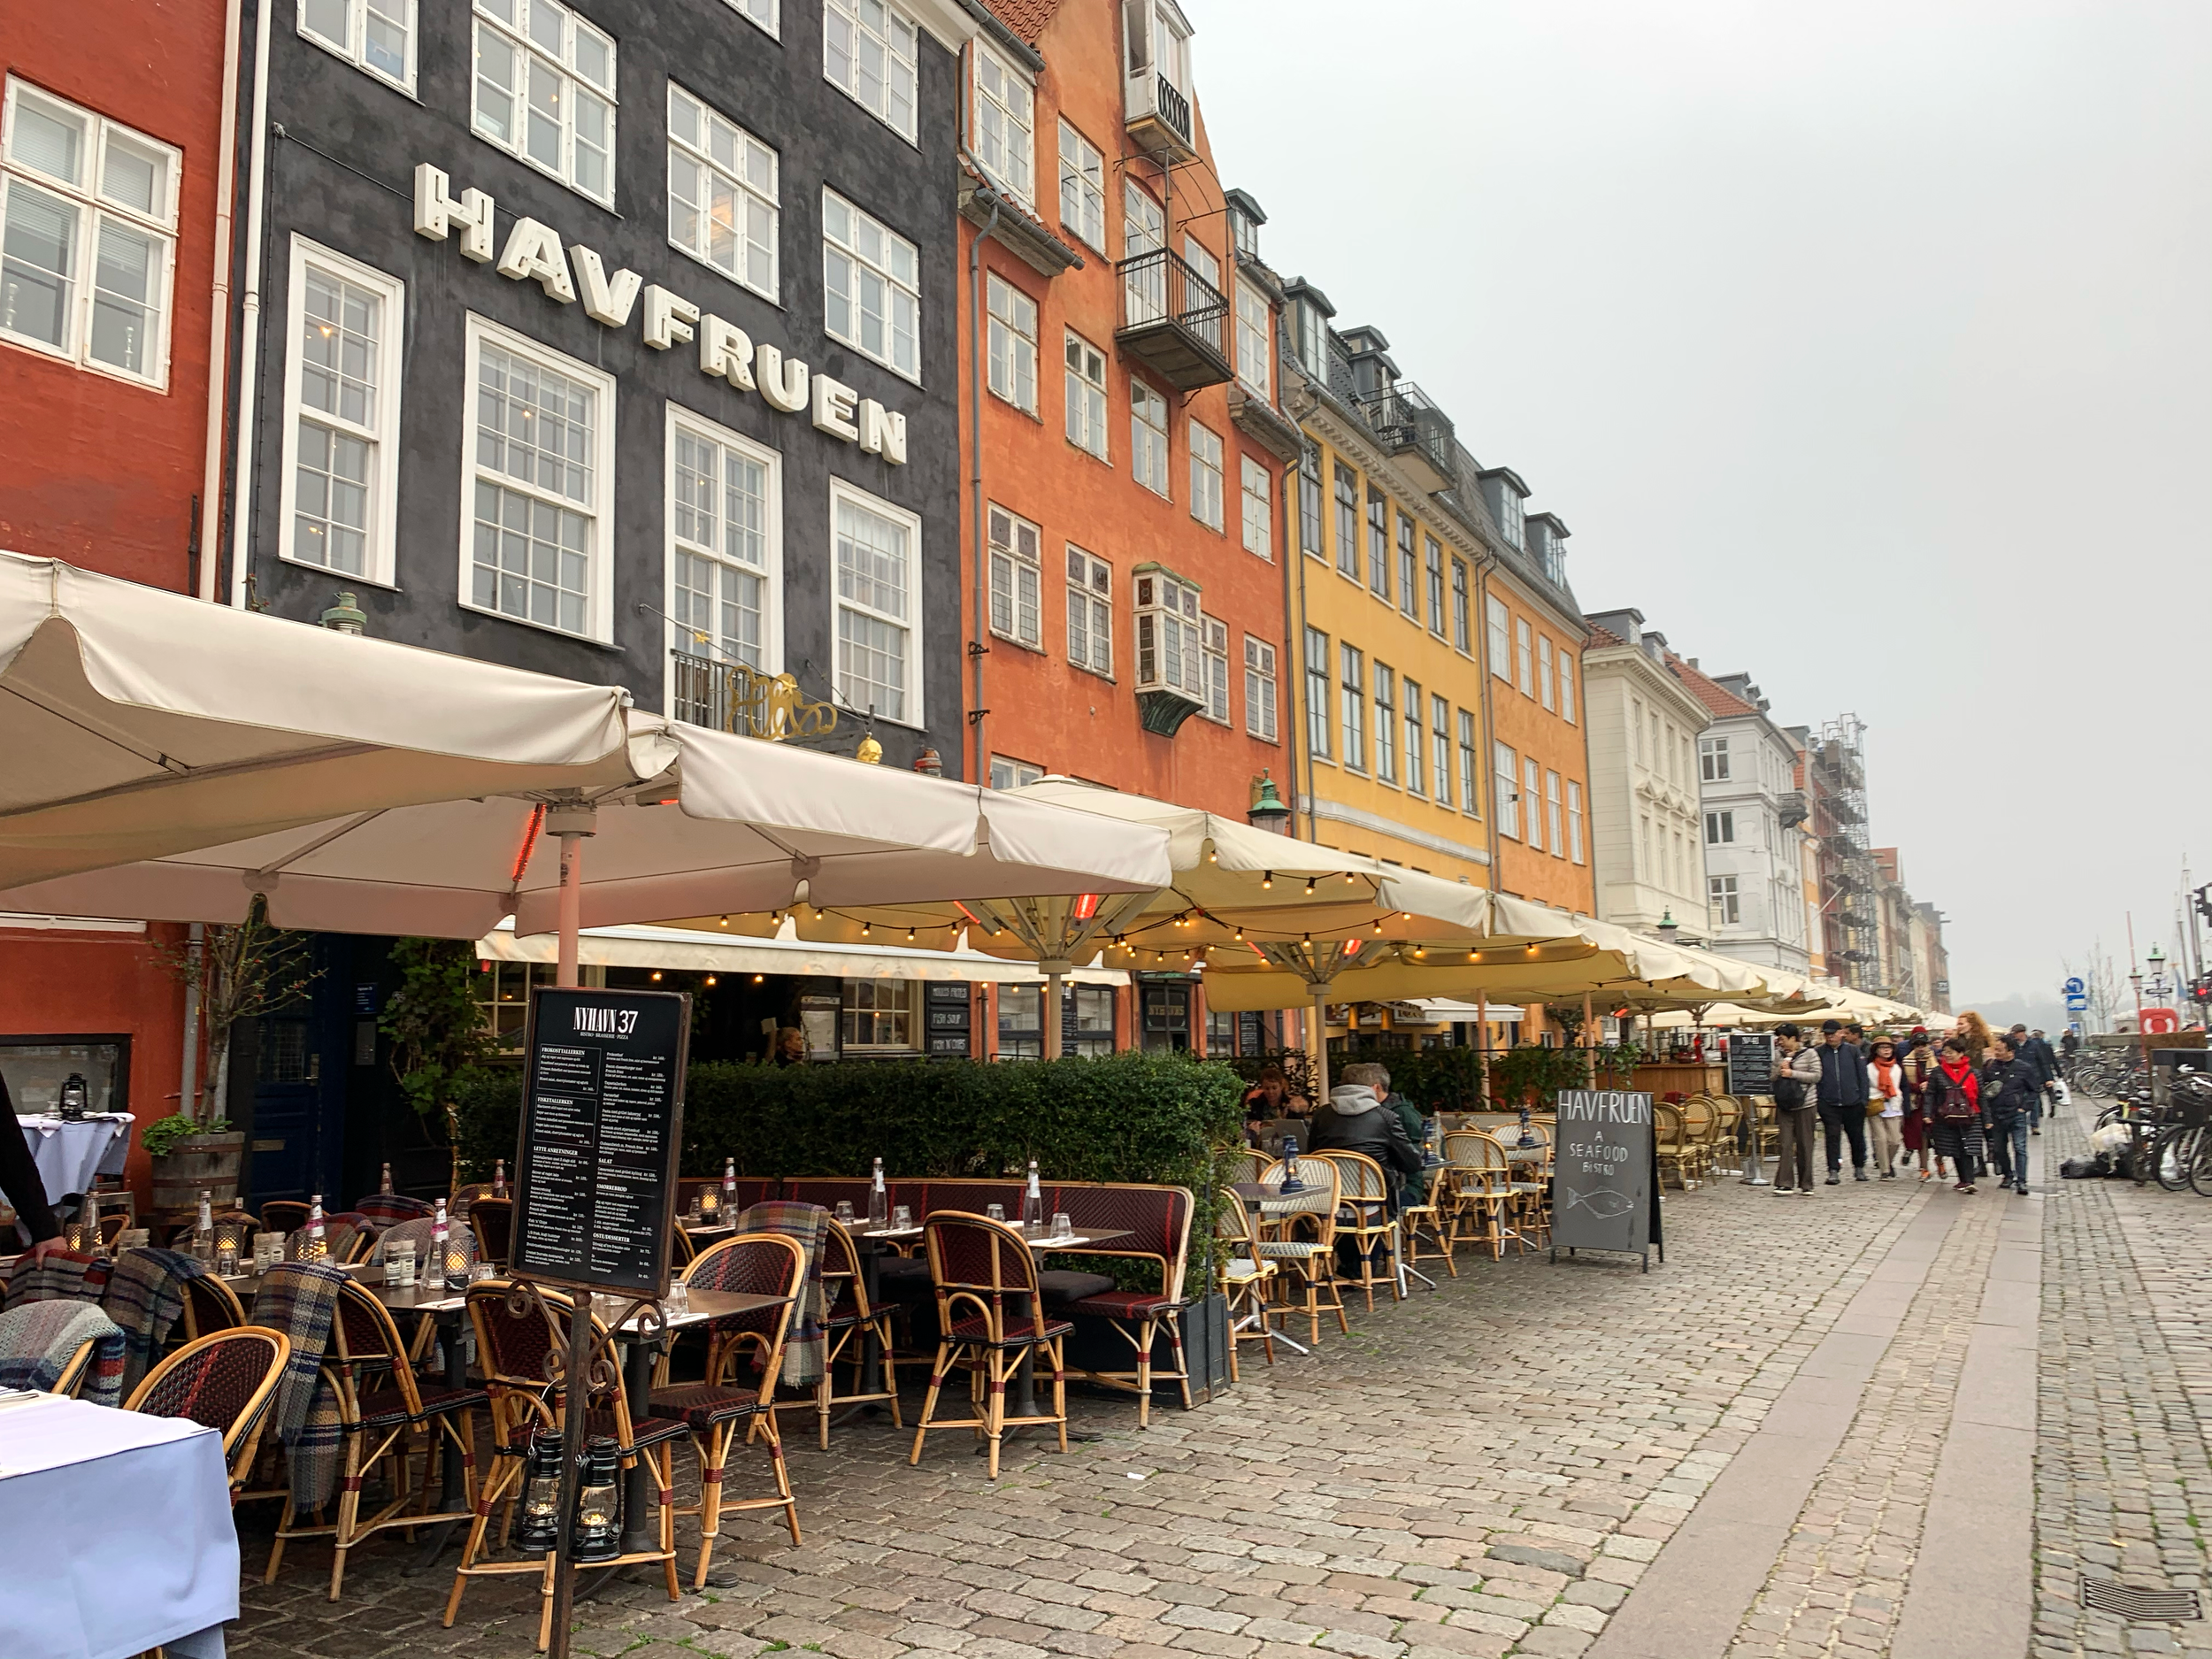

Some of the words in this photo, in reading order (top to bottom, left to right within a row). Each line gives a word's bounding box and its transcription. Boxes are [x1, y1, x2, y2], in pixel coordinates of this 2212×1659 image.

[414, 162, 907, 465] HAVFRUEN
[573, 1007, 617, 1033] NYHAVN
[618, 1010, 639, 1034] 37
[1557, 1090, 1652, 1125] HAVFRUEN
[1594, 1131, 1604, 1142] A
[1569, 1143, 1629, 1162] SEAFOOD
